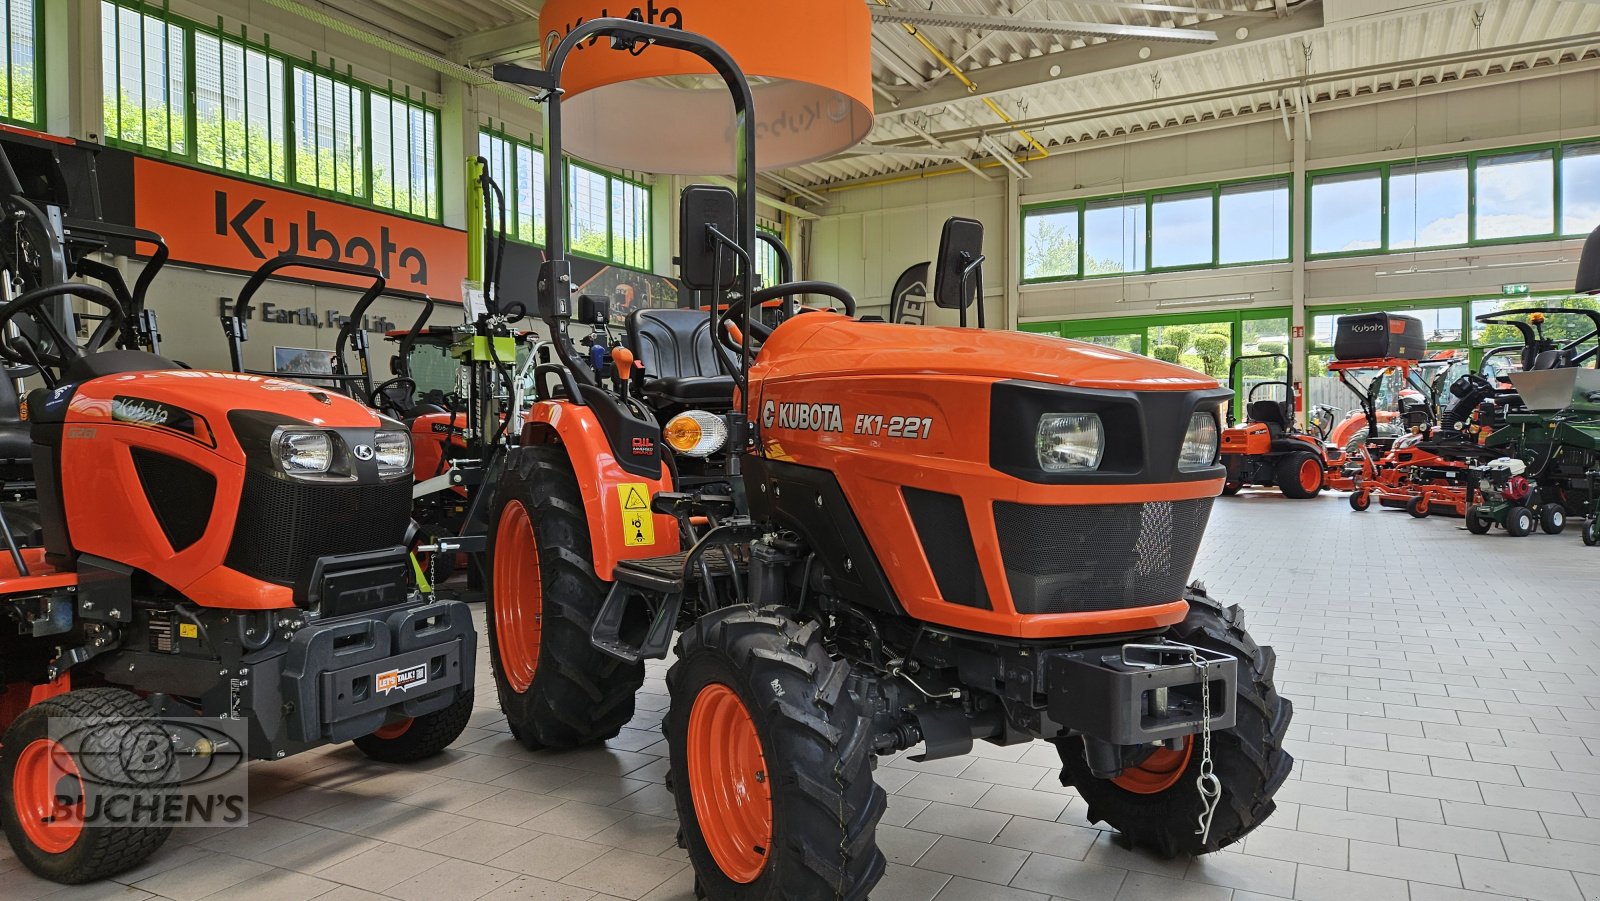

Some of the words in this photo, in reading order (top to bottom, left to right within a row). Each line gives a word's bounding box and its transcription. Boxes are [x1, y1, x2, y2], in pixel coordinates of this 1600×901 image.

[215, 190, 427, 285] Kubota
[219, 297, 256, 320] Fr
[1352, 323, 1384, 333] Kubota
[119, 398, 169, 424] Kubota
[778, 402, 844, 433] KUBOTA
[853, 413, 933, 440] EK1-221
[632, 437, 654, 446] OIL
[379, 676, 396, 688] LET'S
[397, 670, 416, 682] TALK!
